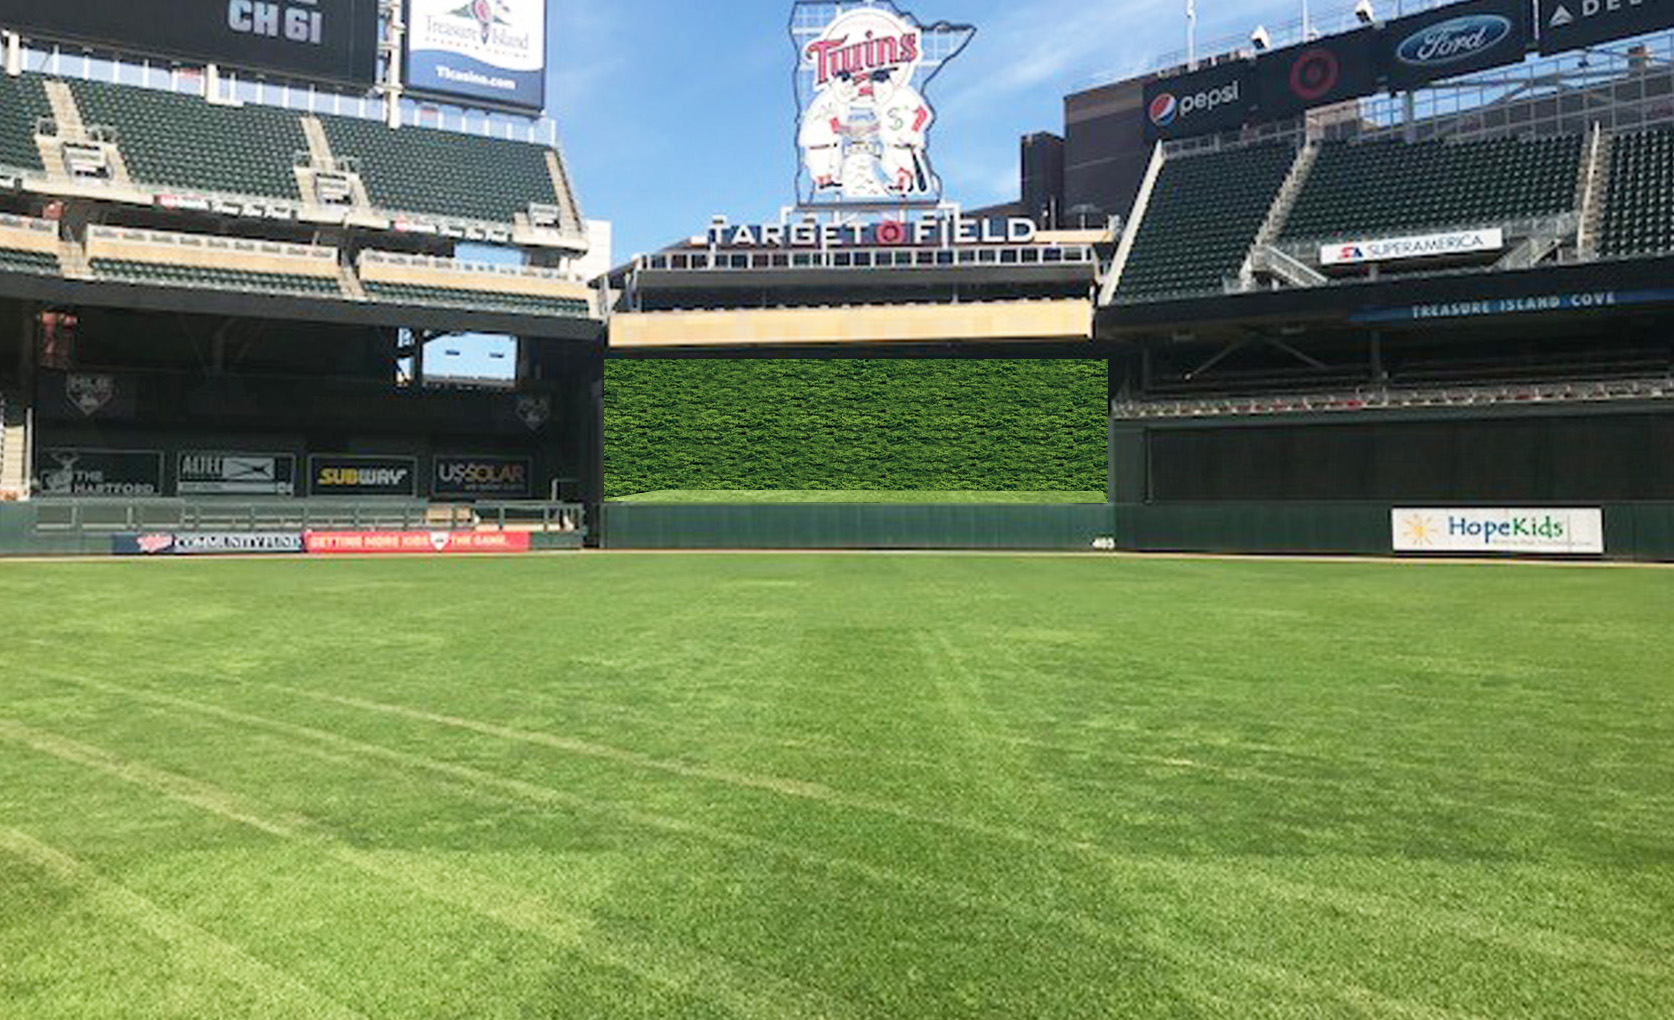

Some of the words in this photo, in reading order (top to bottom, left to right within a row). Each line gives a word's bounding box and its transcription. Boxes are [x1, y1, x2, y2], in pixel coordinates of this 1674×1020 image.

[228, 0, 279, 37] CH
[805, 29, 918, 85] Twins
[1417, 25, 1488, 60] Ford
[1179, 80, 1240, 116] pepsi
[706, 223, 869, 246] TARGET
[914, 216, 1038, 246] FIELD
[1367, 234, 1484, 256] SUPERAMERICA
[1411, 301, 1491, 319] TREASURE
[1500, 297, 1560, 312] ISLAND
[1571, 291, 1615, 307] COVE
[74, 483, 155, 495] HARTFORD
[75, 470, 103, 483] THE
[317, 467, 408, 486] SUBWAY
[1448, 515, 1563, 544] HopeKids
